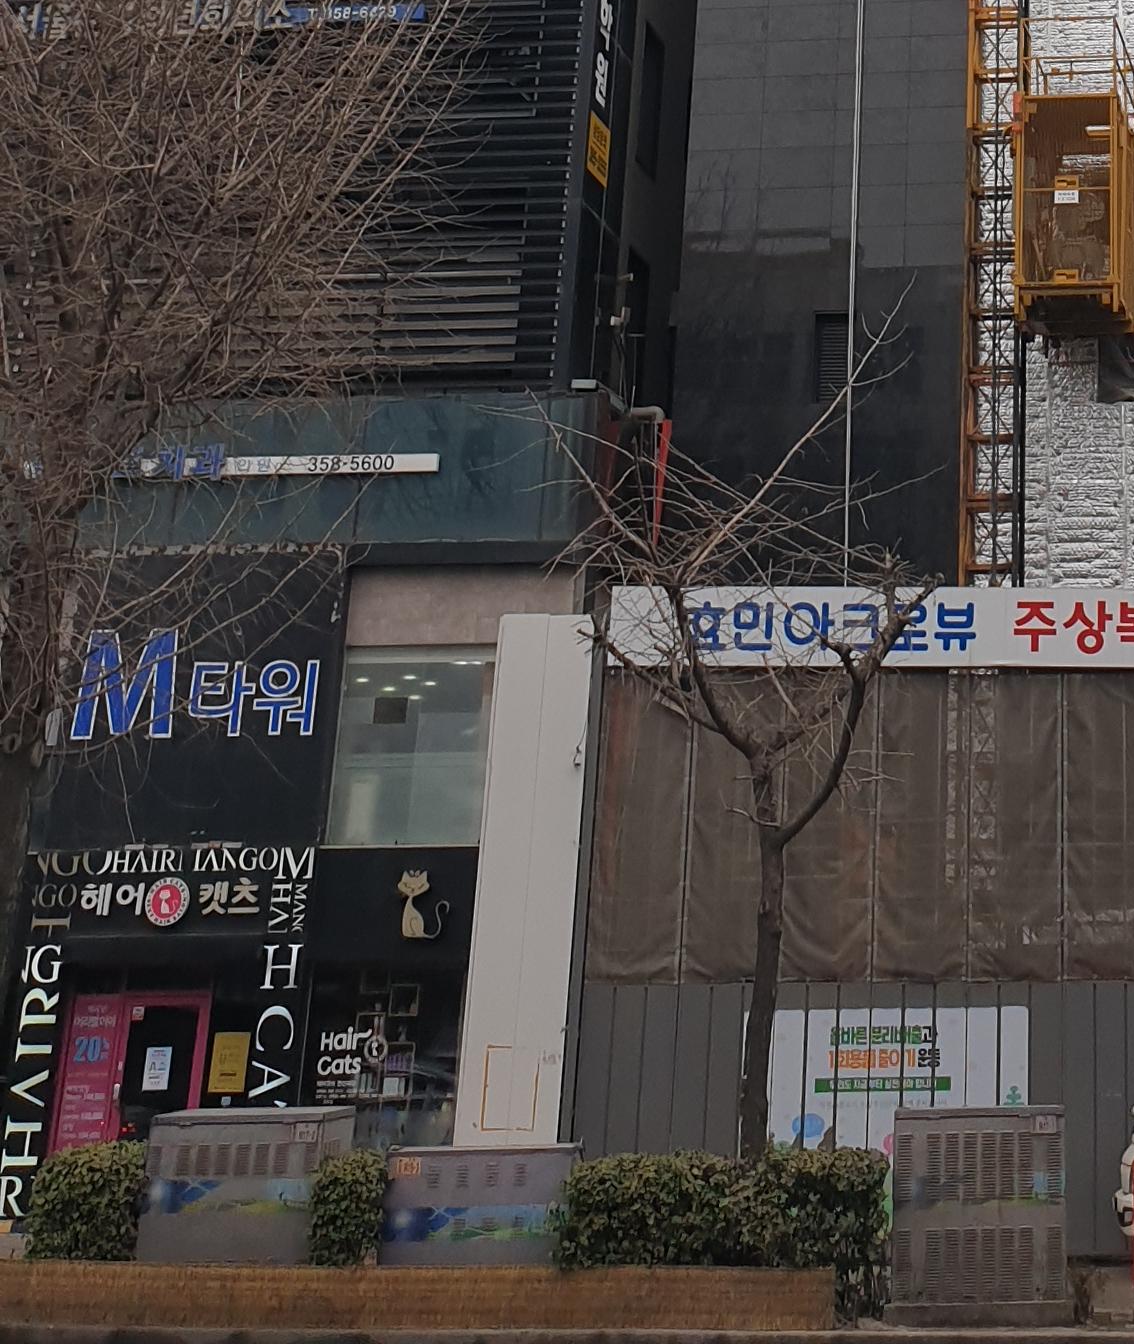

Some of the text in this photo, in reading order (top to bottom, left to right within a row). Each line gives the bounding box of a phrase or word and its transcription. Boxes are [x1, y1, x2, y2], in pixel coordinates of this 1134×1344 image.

[308, 454, 395, 472] 358-5600
[81, 883, 146, 916] 헤어
[199, 877, 260, 915] 캣츠
[320, 1026, 372, 1051] Hair
[317, 1054, 362, 1076] Cats
